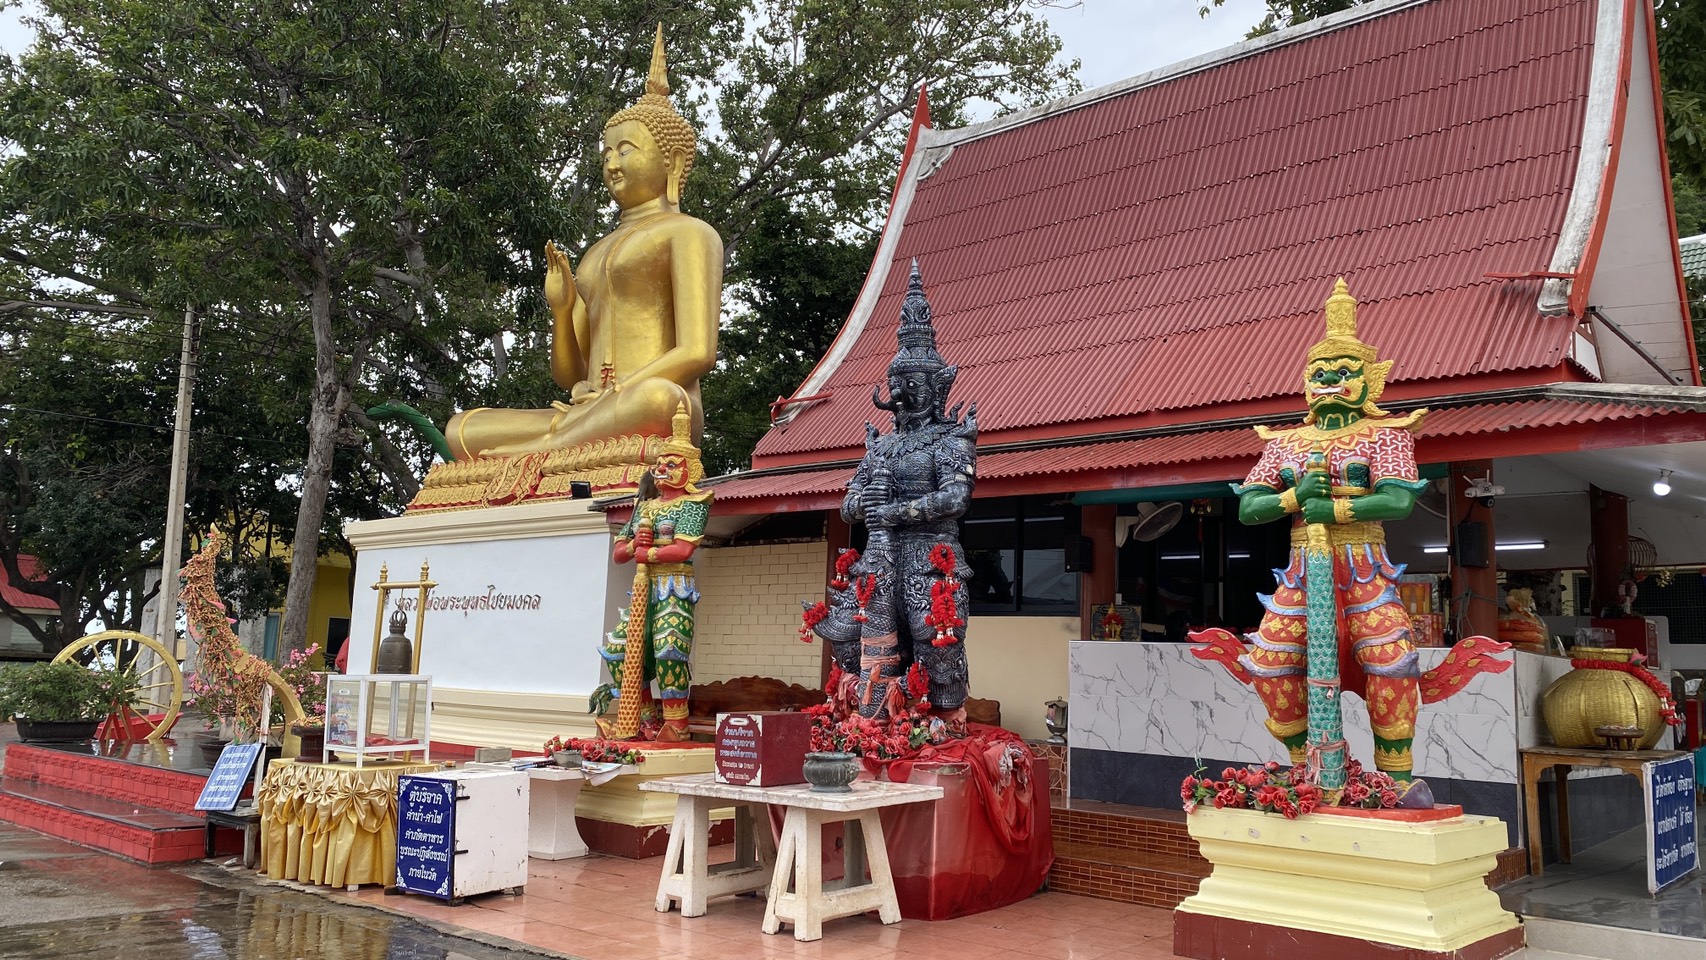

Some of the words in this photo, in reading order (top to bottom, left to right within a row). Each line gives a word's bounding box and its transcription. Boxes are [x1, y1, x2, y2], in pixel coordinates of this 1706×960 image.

[395, 584, 542, 618] หลวพ่อพระพุทธไชยมงคล
[409, 786, 443, 807] ตู้บริจาค
[406, 805, 444, 824] ค่าน้ำ-ค่าไฟ
[408, 864, 437, 881] ภายในวัด
